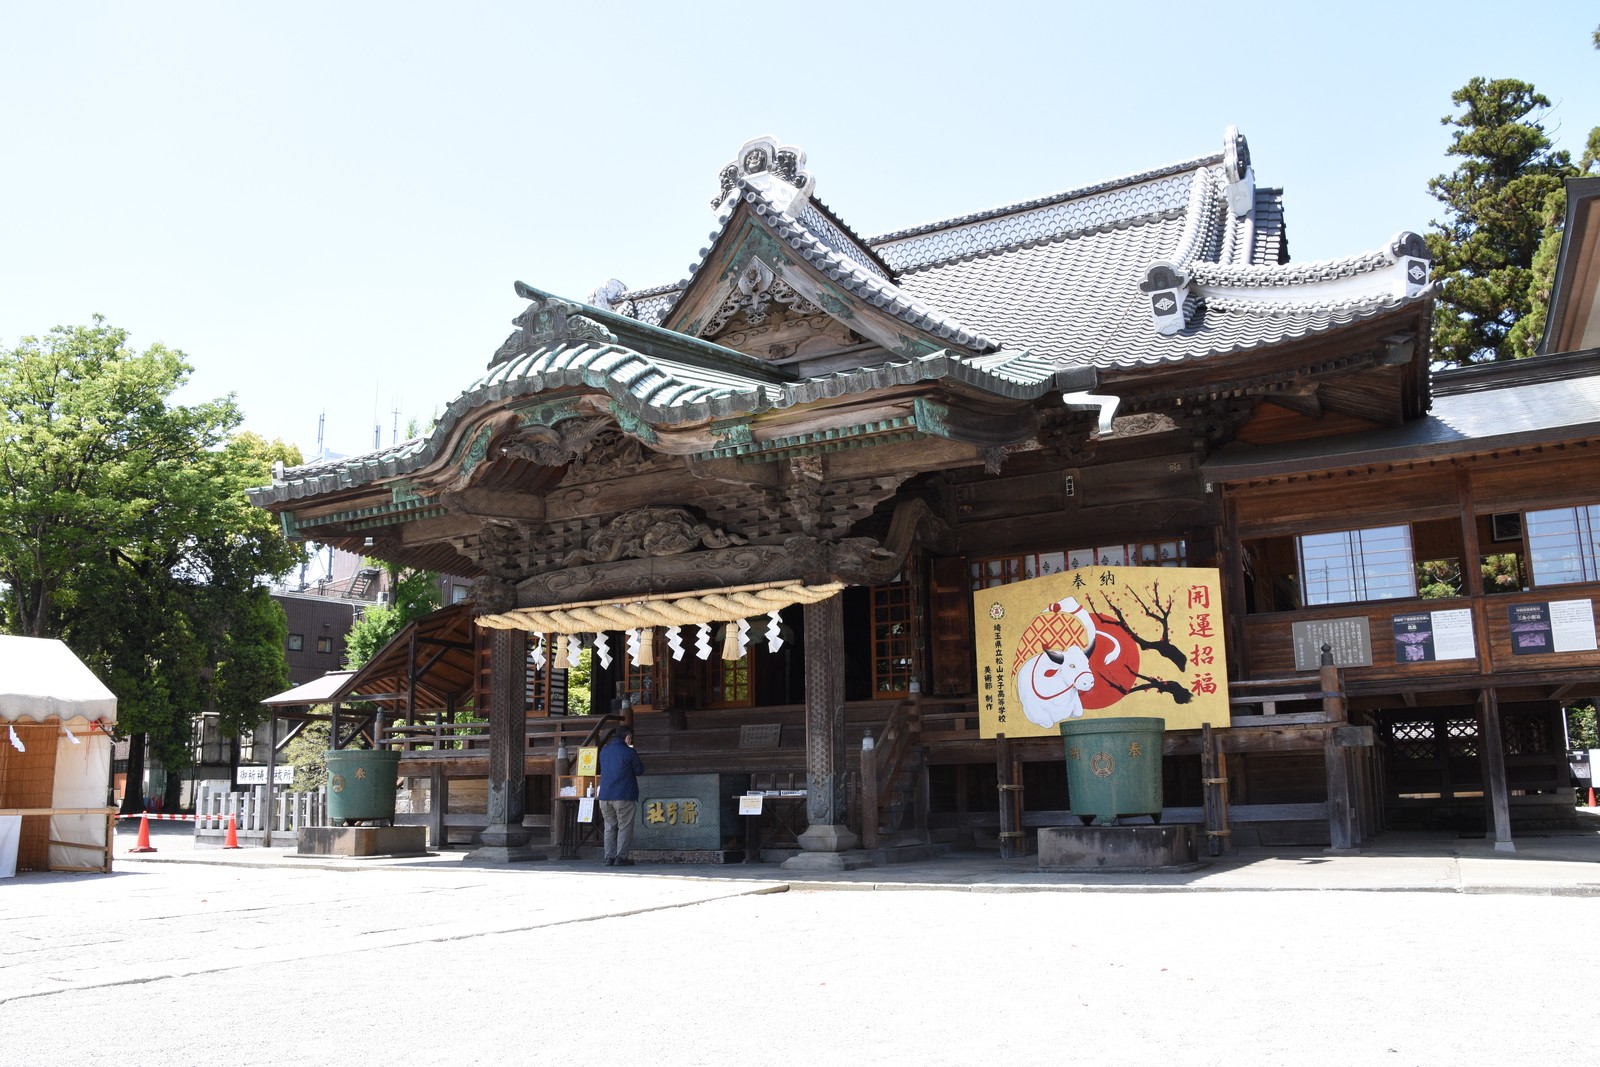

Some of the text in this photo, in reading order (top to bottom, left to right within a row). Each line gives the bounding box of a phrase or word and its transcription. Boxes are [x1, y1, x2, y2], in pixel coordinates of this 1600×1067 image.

[1072, 570, 1116, 590] 奉納
[1187, 584, 1218, 697] 開運招福
[984, 665, 993, 711] 美術部 制作
[993, 623, 1007, 723] 埼玉県立松山女子高等学校
[1129, 741, 1142, 758] 奉
